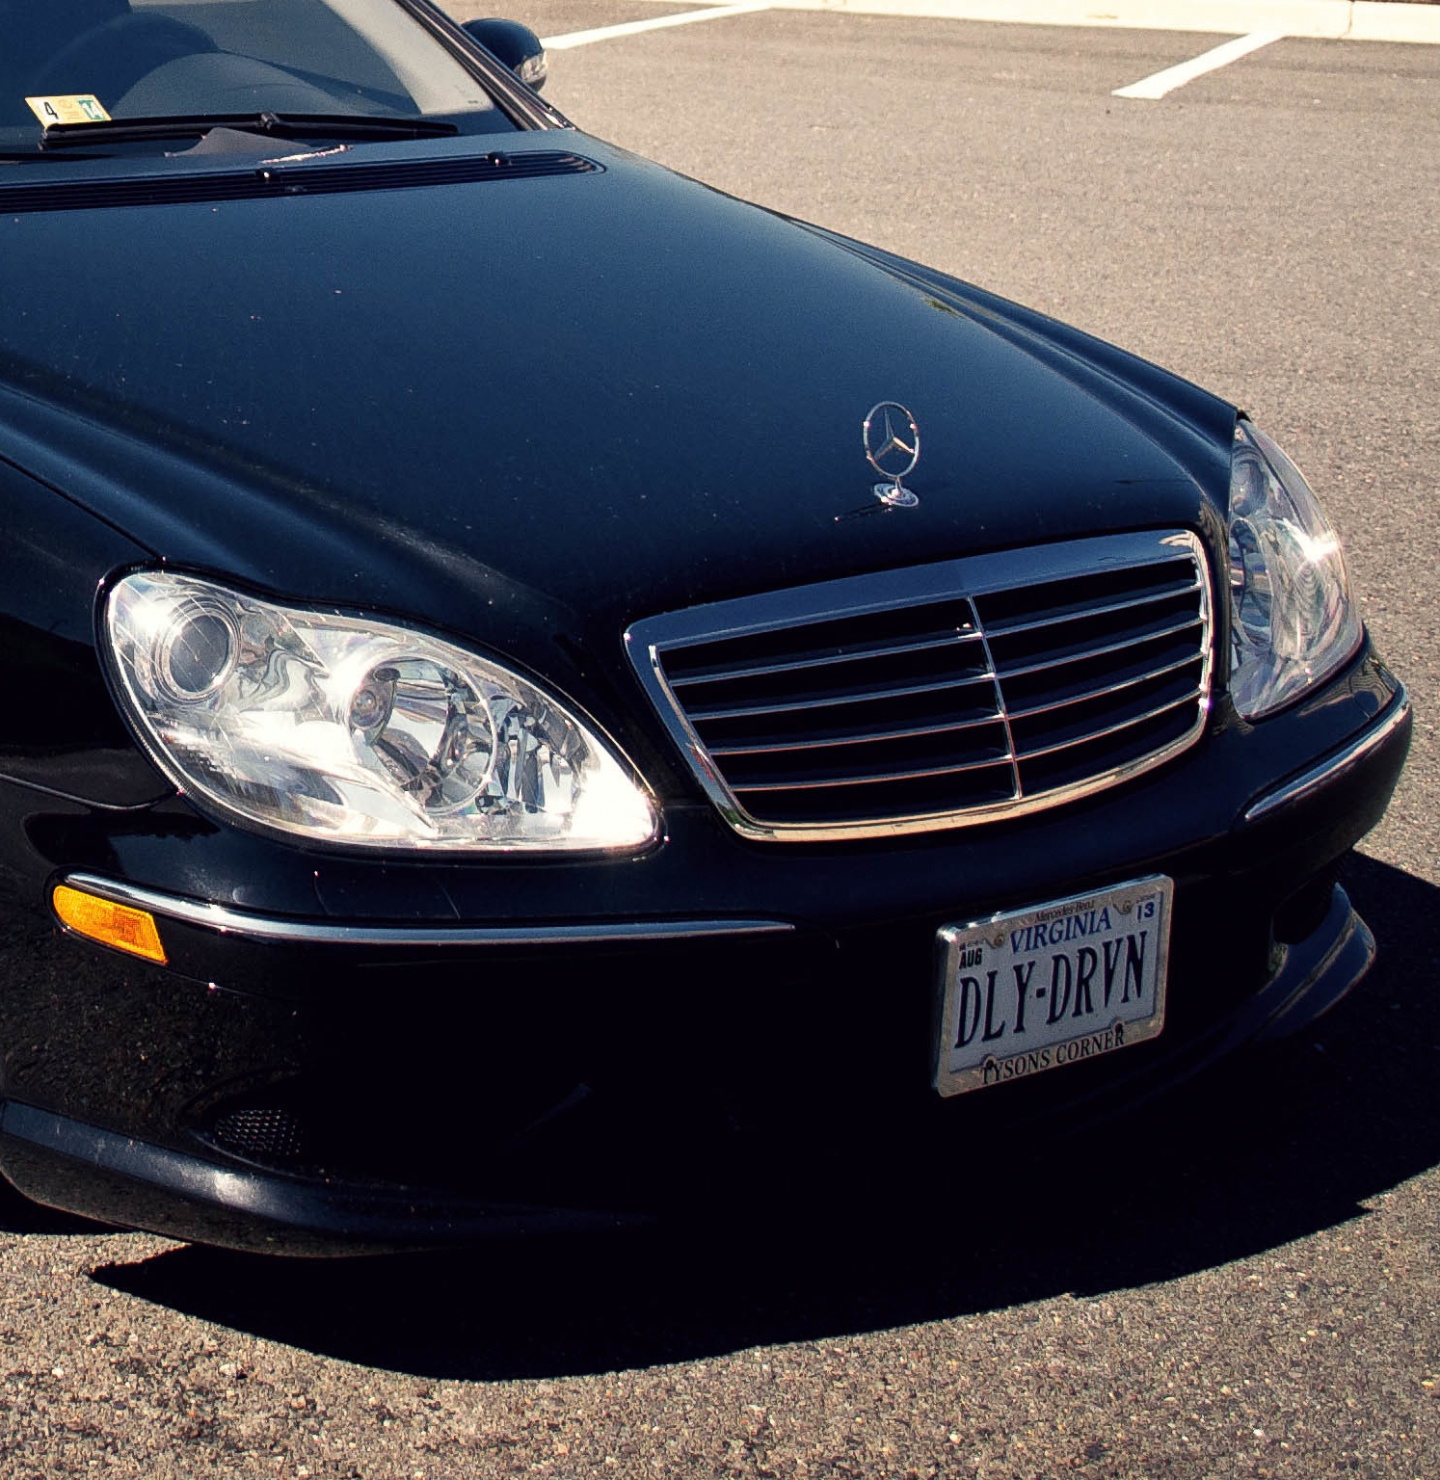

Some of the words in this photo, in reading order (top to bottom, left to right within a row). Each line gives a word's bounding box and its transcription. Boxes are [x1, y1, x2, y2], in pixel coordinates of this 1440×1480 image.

[43, 101, 59, 120] 4
[1137, 901, 1155, 920] 13
[1010, 907, 1111, 954] VIRGINIA
[959, 947, 982, 969] AUG
[954, 931, 1147, 1049] DLY-DRVN
[981, 1048, 1050, 1085] TYSONS
[1055, 1027, 1125, 1066] CORNER
